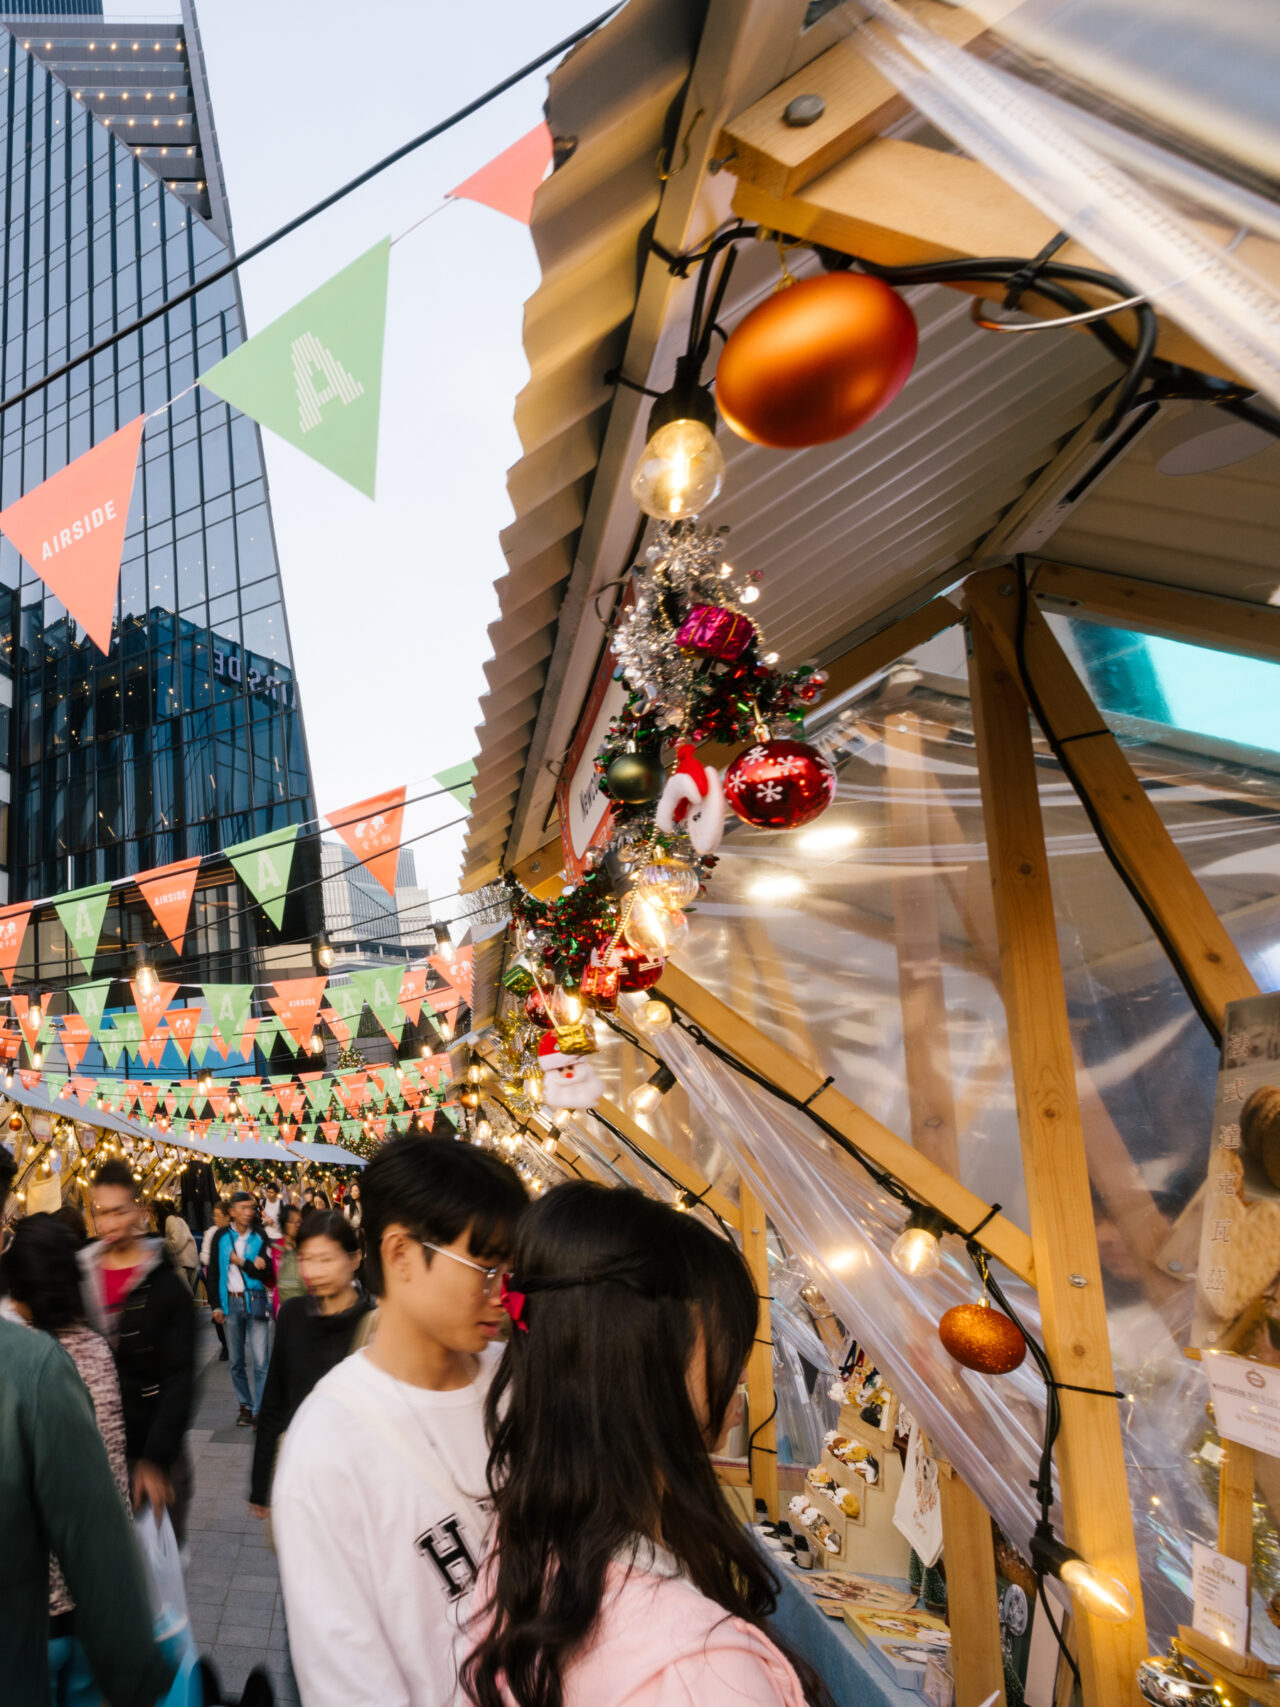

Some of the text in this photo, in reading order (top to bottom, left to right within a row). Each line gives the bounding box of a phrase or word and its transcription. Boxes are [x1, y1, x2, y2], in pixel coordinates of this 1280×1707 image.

[291, 331, 365, 433] A
[41, 499, 117, 562] AIRSIDE
[257, 851, 282, 892] A
[154, 889, 188, 907] AIRSIDE
[75, 902, 95, 940] A
[85, 991, 100, 1017] A
[289, 997, 317, 1007] AIRSIDE
[343, 992, 358, 1017] A
[374, 977, 393, 1007] A
[220, 994, 235, 1021] A
[126, 1020, 139, 1041] A
[109, 1036, 120, 1053] A
